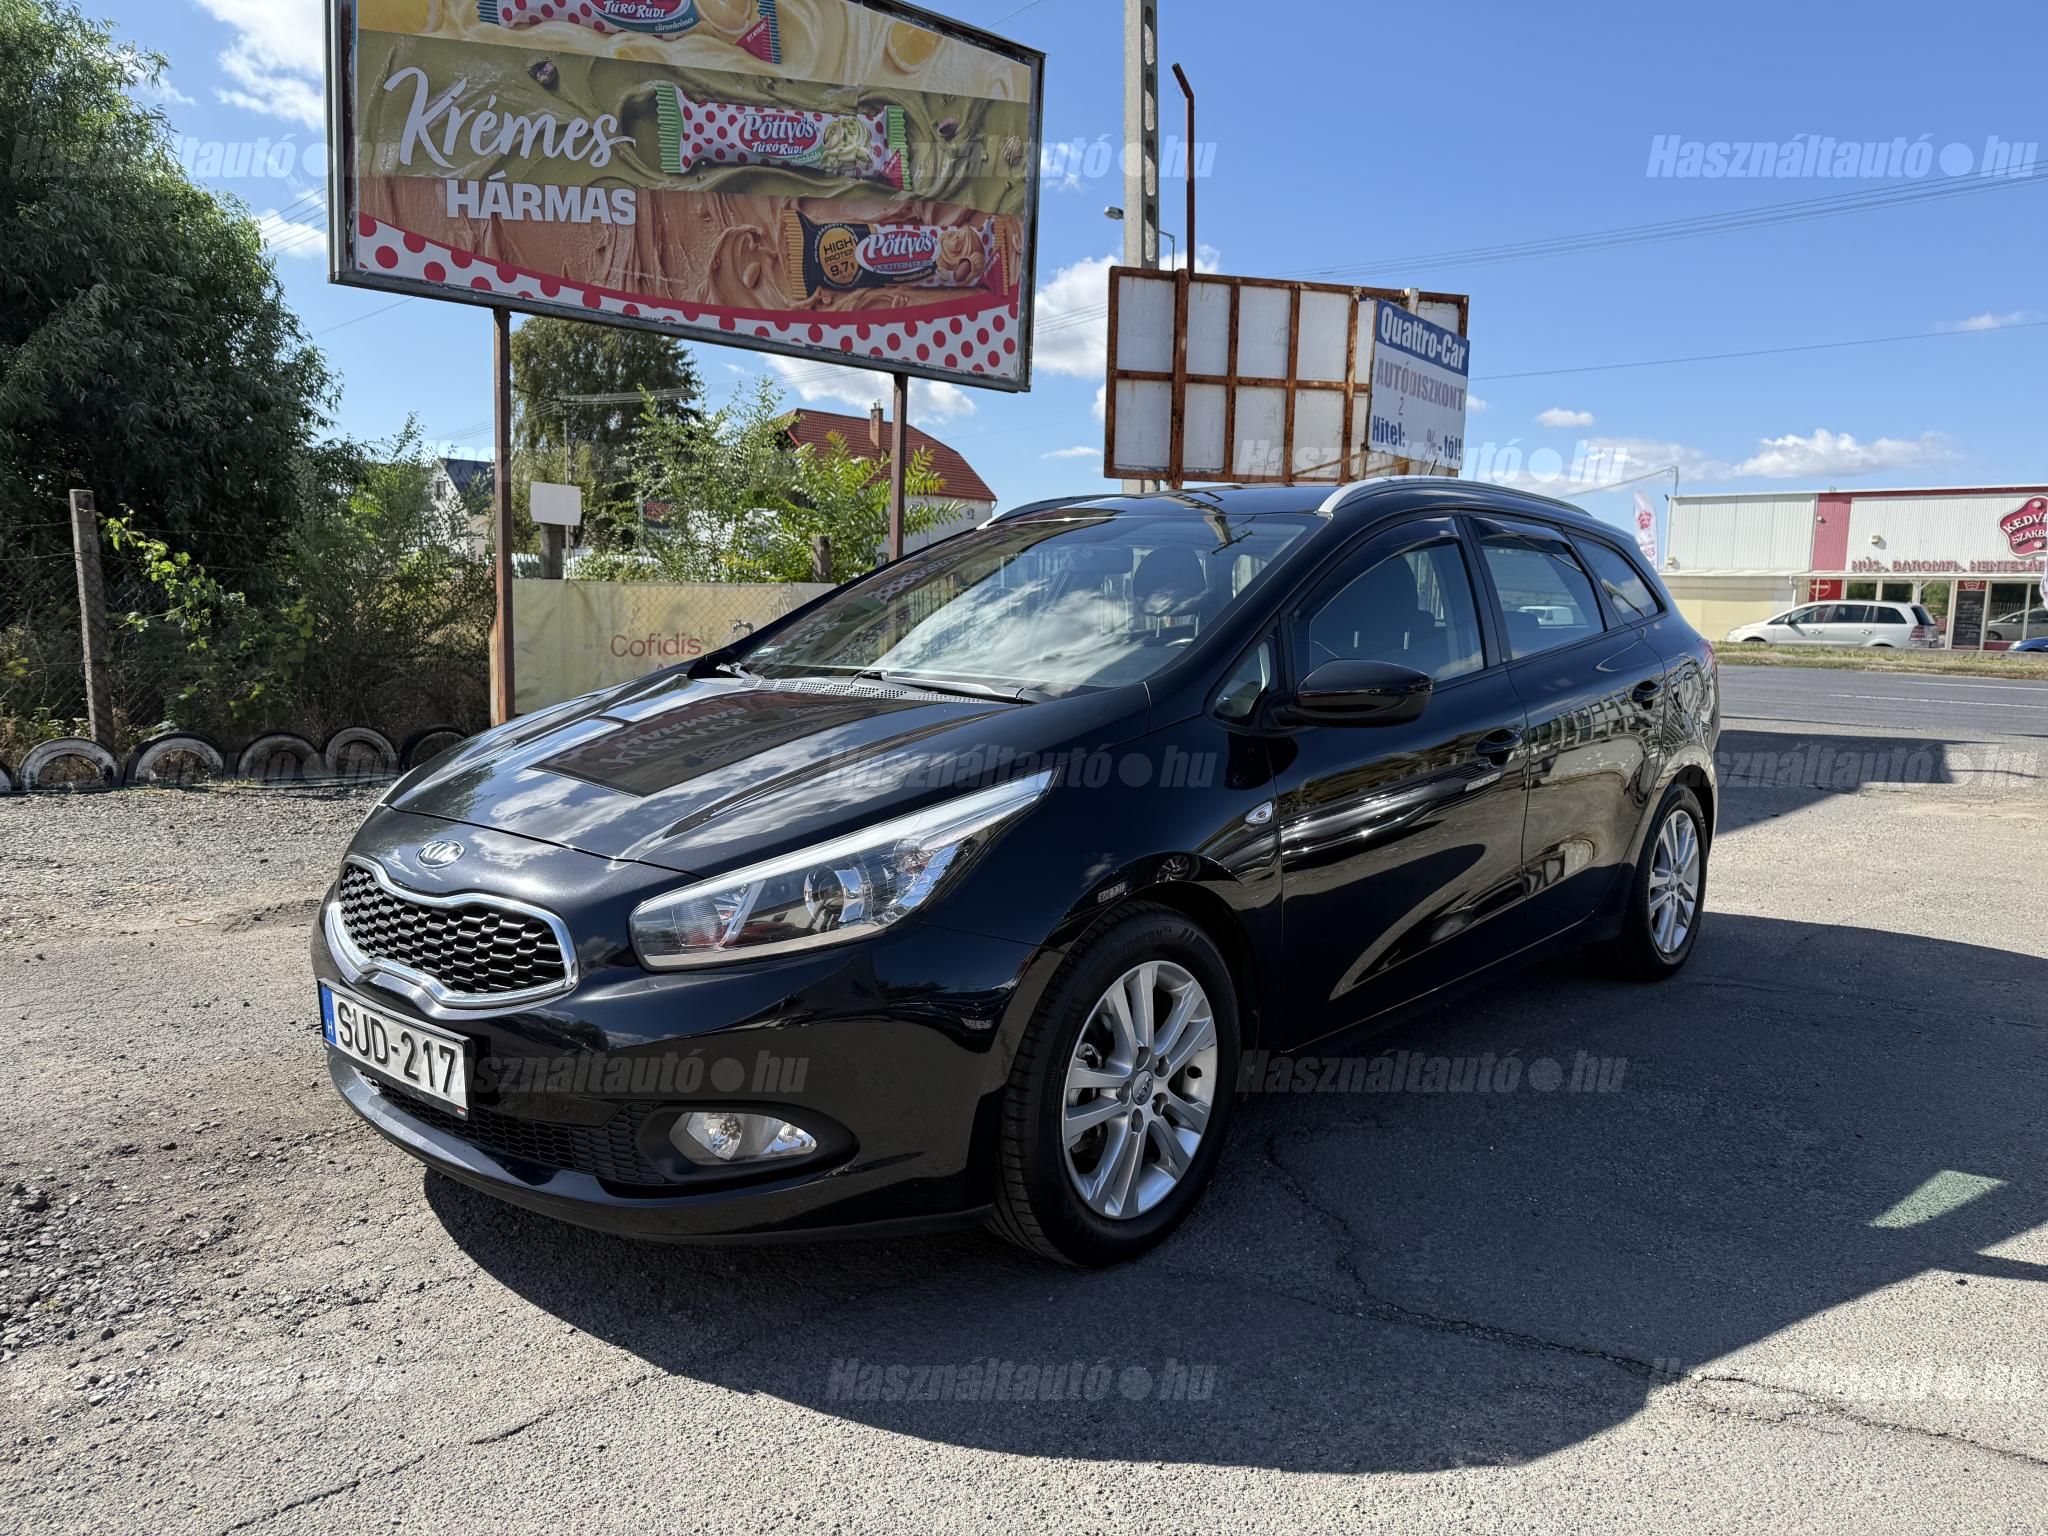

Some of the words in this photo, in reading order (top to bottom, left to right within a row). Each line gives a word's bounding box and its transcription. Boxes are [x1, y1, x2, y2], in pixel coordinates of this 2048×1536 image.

[383, 66, 637, 169] Krémes
[744, 113, 816, 144] Pöttyös
[446, 170, 637, 226] HÁRMAS
[823, 237, 854, 255] HIGH
[866, 231, 934, 259] Pöttyös
[1381, 305, 1466, 371] Quattro-Car
[1376, 358, 1465, 412] AUTÓDISZKONT
[1372, 415, 1406, 448] Hitel:
[610, 632, 702, 658] Cofidis
[327, 1018, 334, 1034] H
[337, 1001, 456, 1094] SUD-217
